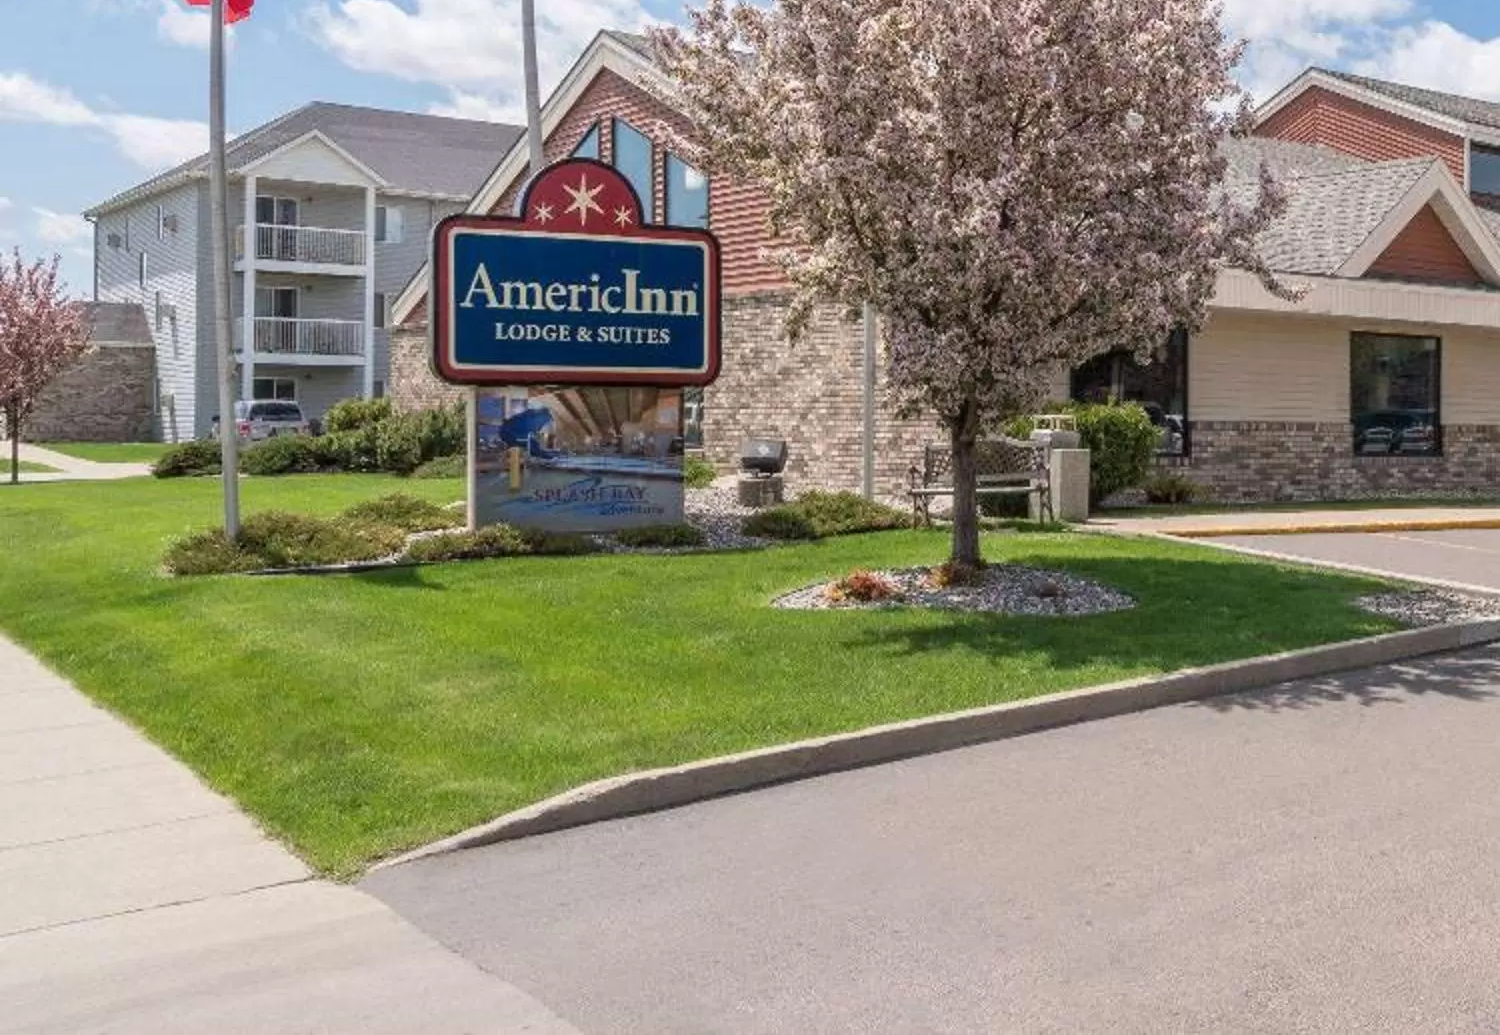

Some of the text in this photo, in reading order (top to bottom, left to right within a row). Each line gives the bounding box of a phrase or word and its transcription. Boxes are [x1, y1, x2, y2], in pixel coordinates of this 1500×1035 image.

[459, 262, 699, 316] AmericInn
[495, 322, 671, 344] LODGE & SUITES
